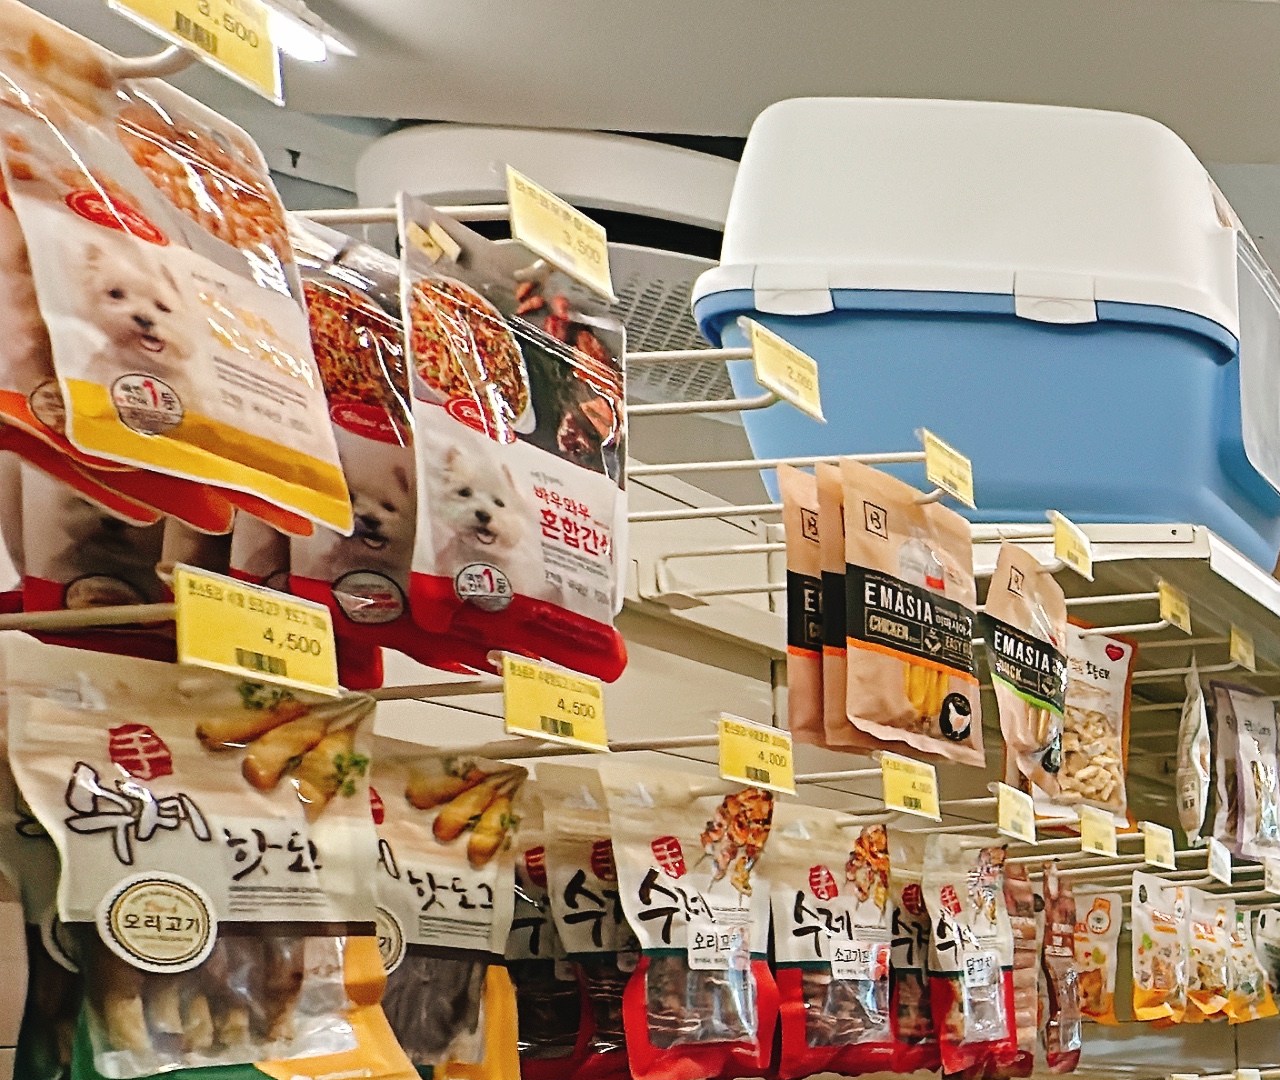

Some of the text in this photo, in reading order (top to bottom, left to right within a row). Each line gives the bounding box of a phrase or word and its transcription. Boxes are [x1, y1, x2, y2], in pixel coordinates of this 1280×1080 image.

[864, 581, 933, 622] EMASIA
[869, 613, 909, 641] CHICKEN
[993, 630, 1050, 674] EMASIA
[123, 913, 201, 934] 오리고기
